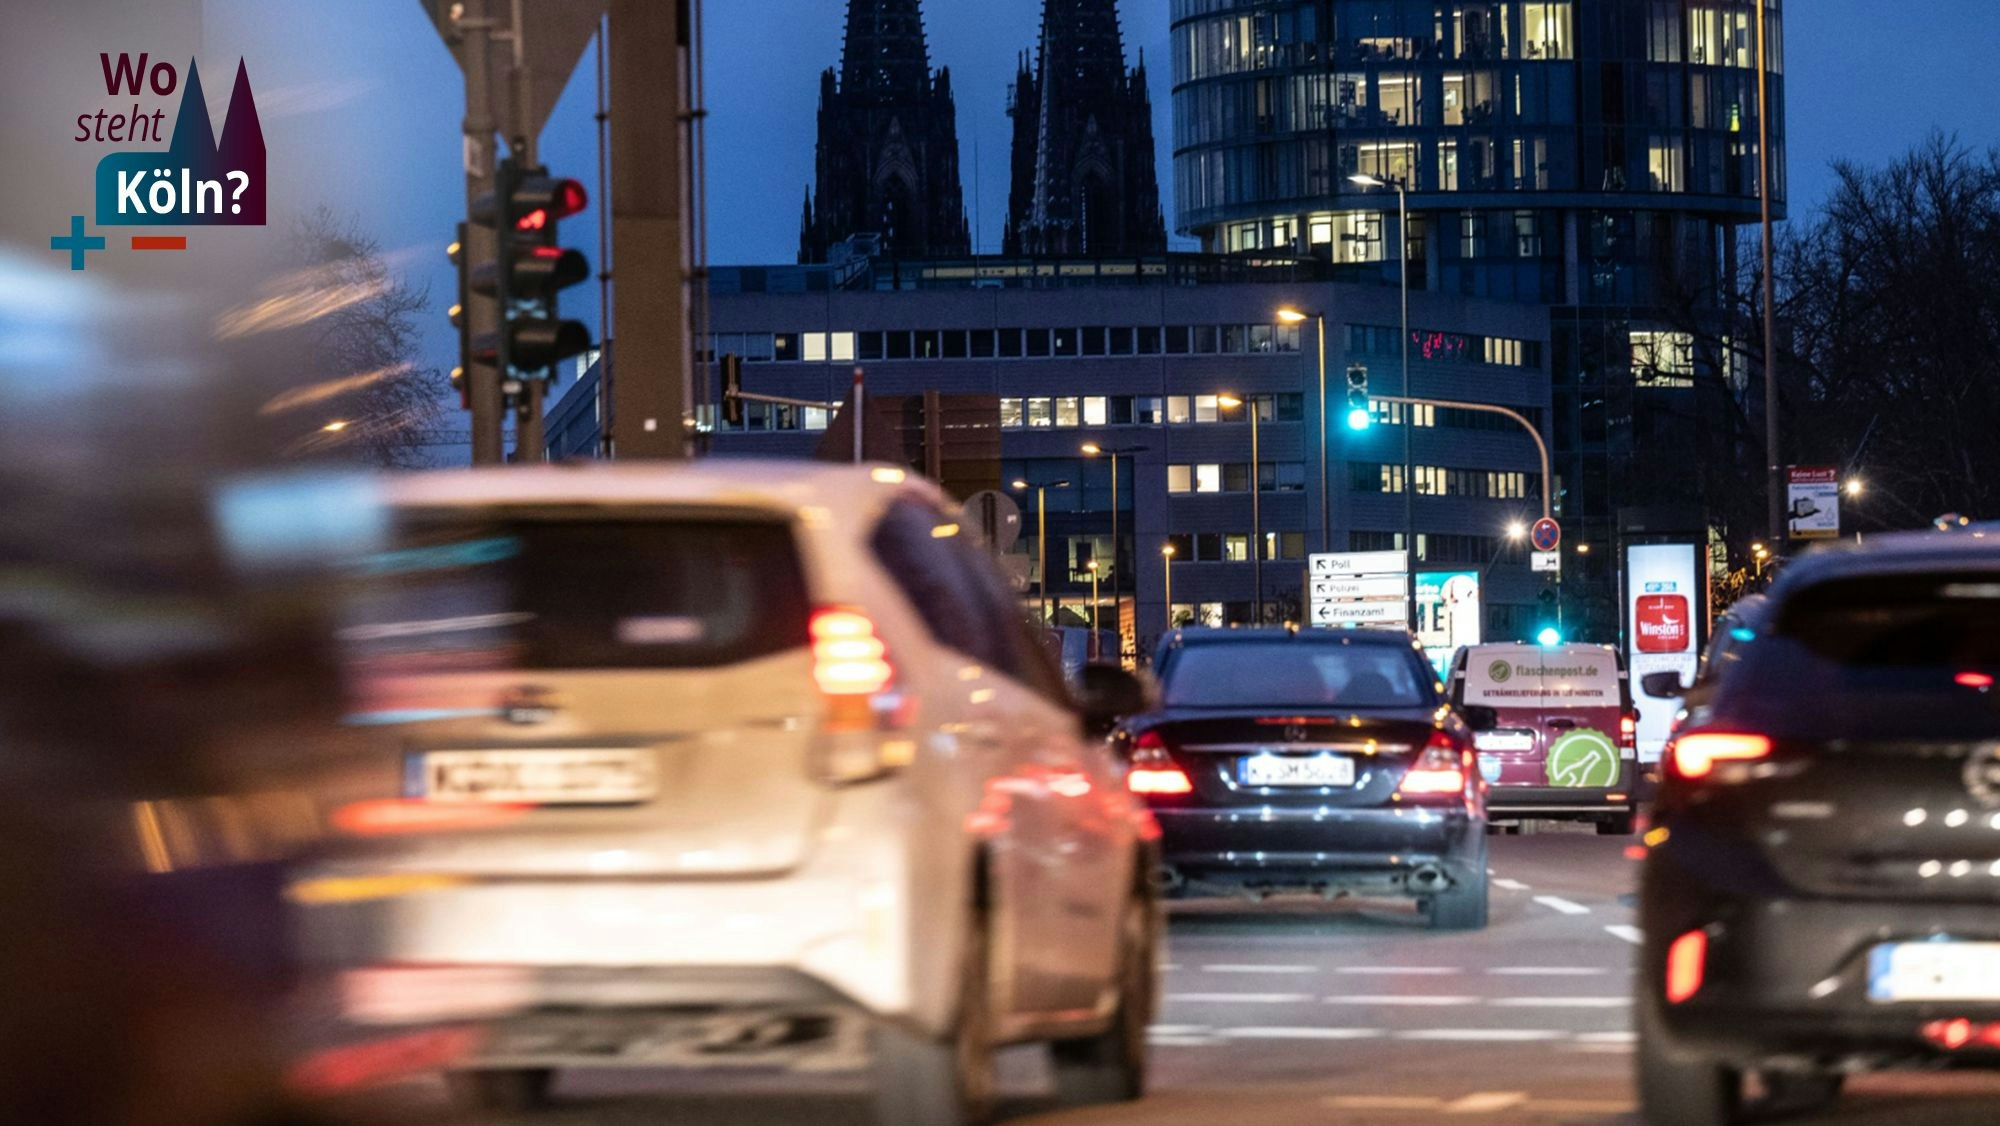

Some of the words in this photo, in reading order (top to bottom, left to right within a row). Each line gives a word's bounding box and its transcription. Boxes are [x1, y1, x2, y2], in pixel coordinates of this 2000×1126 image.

[1331, 559, 1350, 568] Poll
[1329, 584, 1360, 592] Polizei
[1333, 607, 1385, 616] Finanzamt
[1640, 620, 1679, 636] Winston
[1516, 665, 1598, 677] flaschenpost.de
[1483, 689, 1551, 697] GETRÄNKELIEFERUNG
[1575, 689, 1604, 697] MINUTEN
